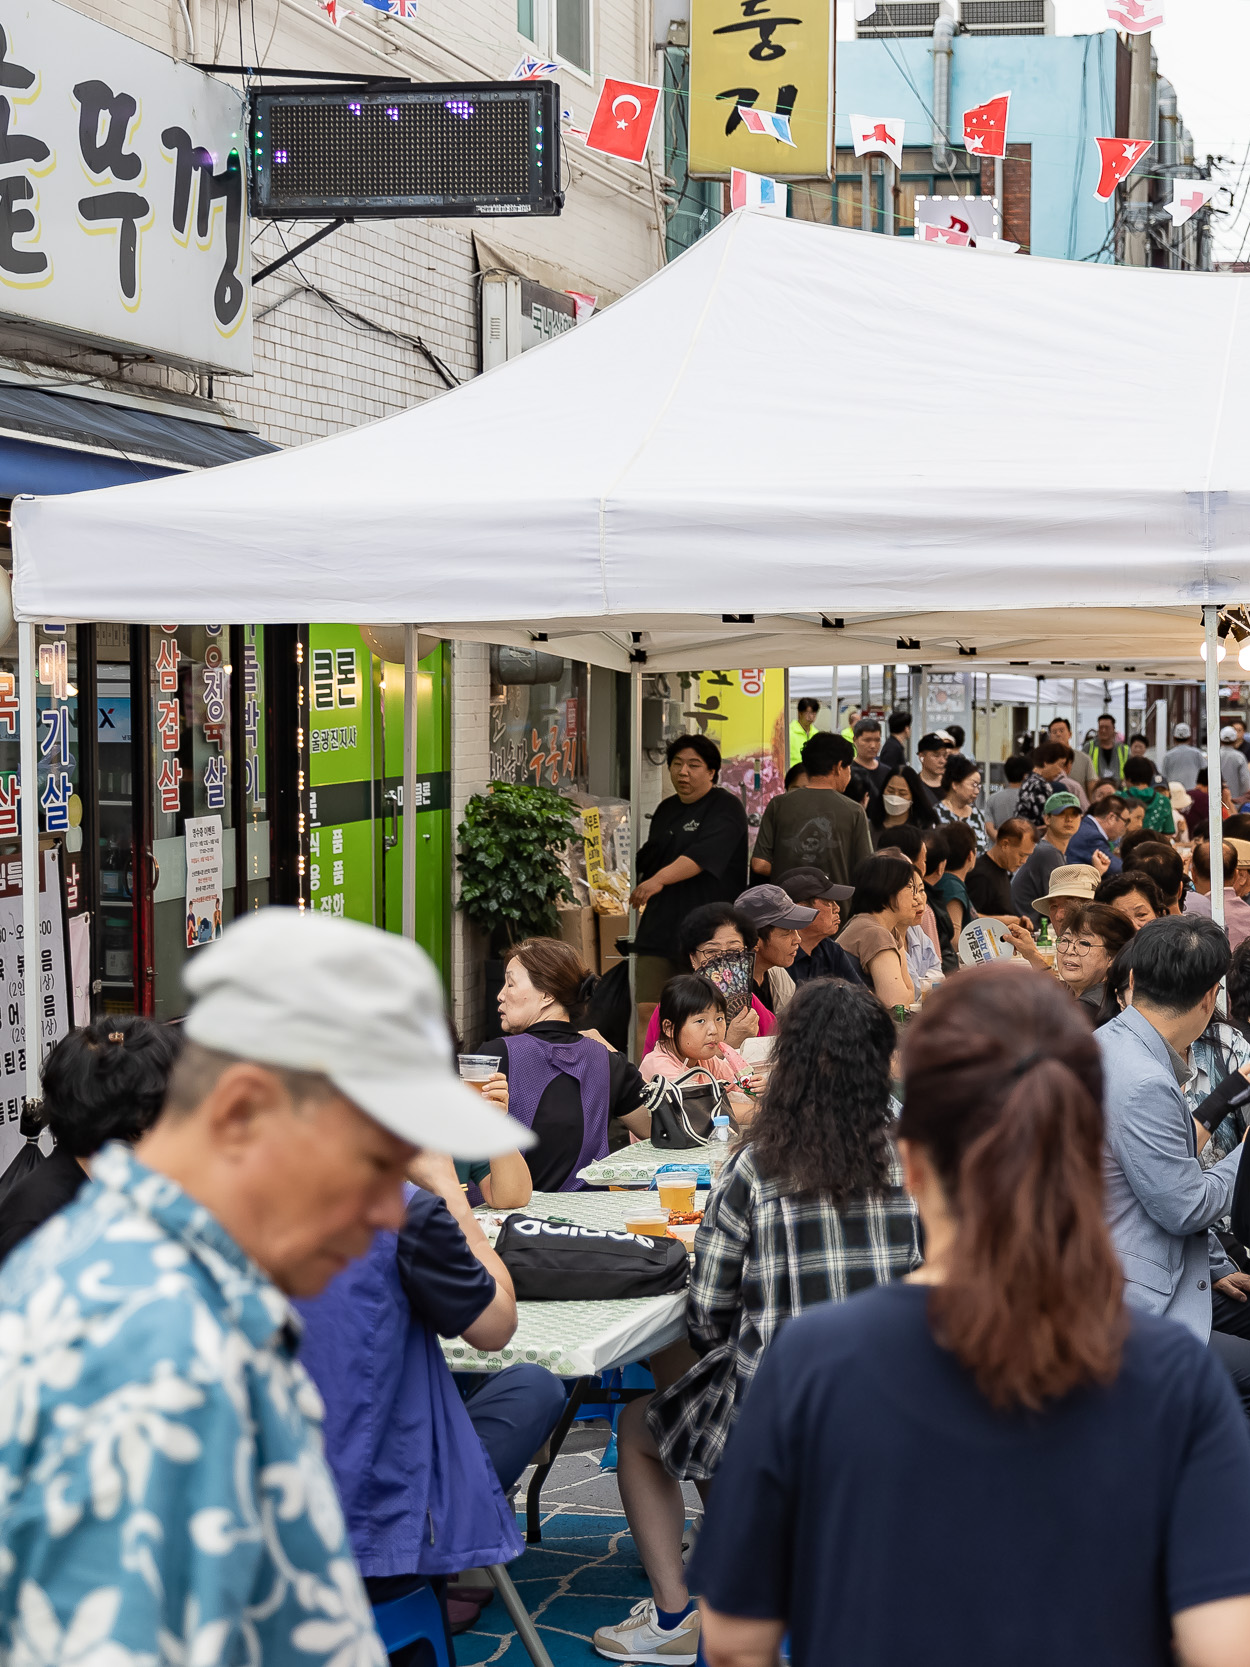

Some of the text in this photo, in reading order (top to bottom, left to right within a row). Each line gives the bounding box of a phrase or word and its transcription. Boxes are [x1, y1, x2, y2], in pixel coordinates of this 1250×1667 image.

[309, 648, 357, 711] 클론
[40, 624, 71, 832] 매기살
[156, 624, 183, 813] 삼겹살
[309, 725, 358, 754] 울광진지사
[529, 725, 577, 786] 누룽지
